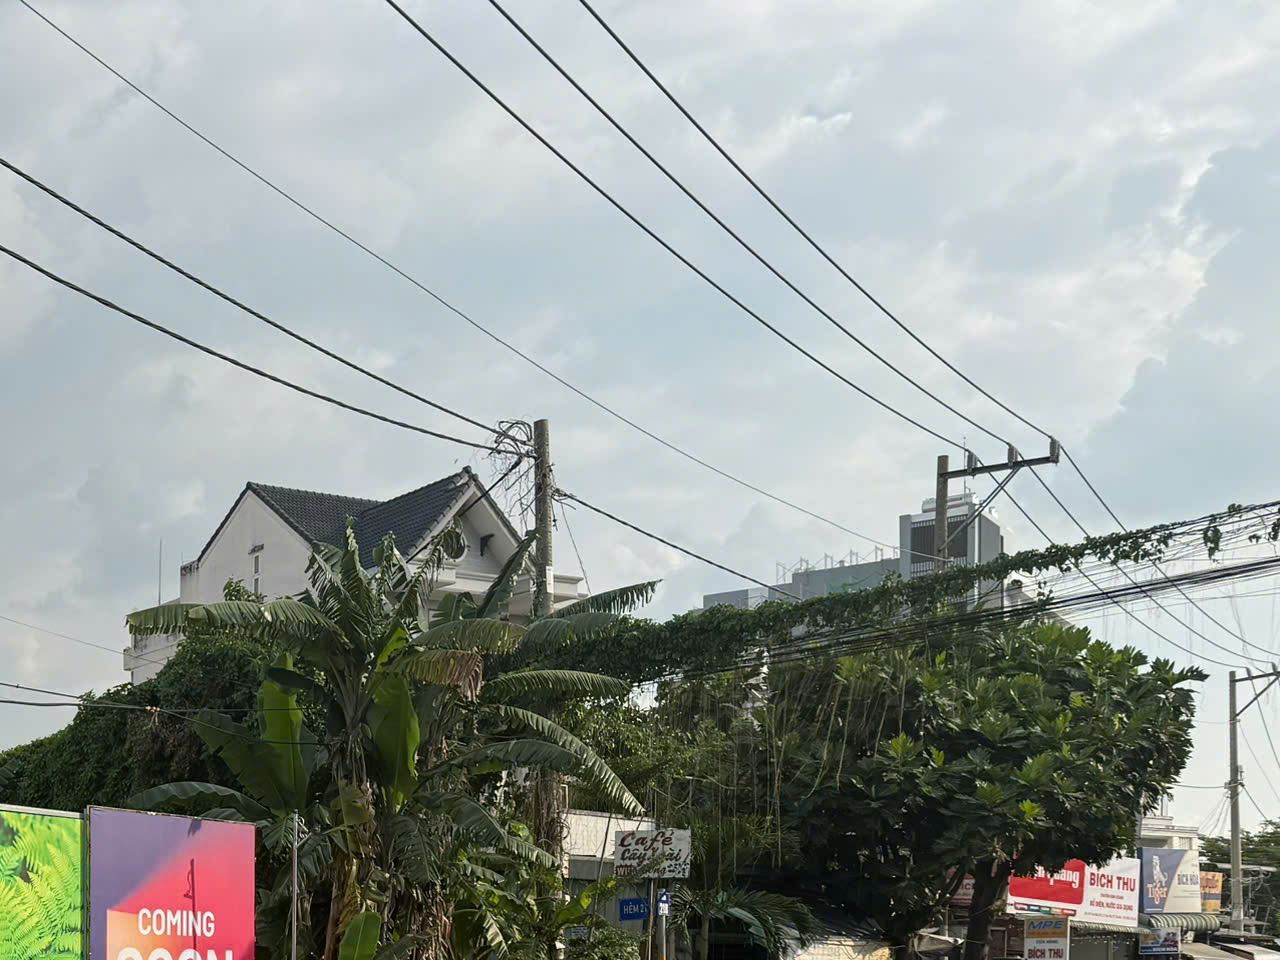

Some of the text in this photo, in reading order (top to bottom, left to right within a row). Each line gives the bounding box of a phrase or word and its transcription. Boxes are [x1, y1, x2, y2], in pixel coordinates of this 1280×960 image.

[1116, 876, 1137, 892] THU
[1147, 882, 1169, 905] Tiger
[138, 908, 215, 938] COMING
[1028, 920, 1065, 929] MPE
[1048, 948, 1064, 958] THU
